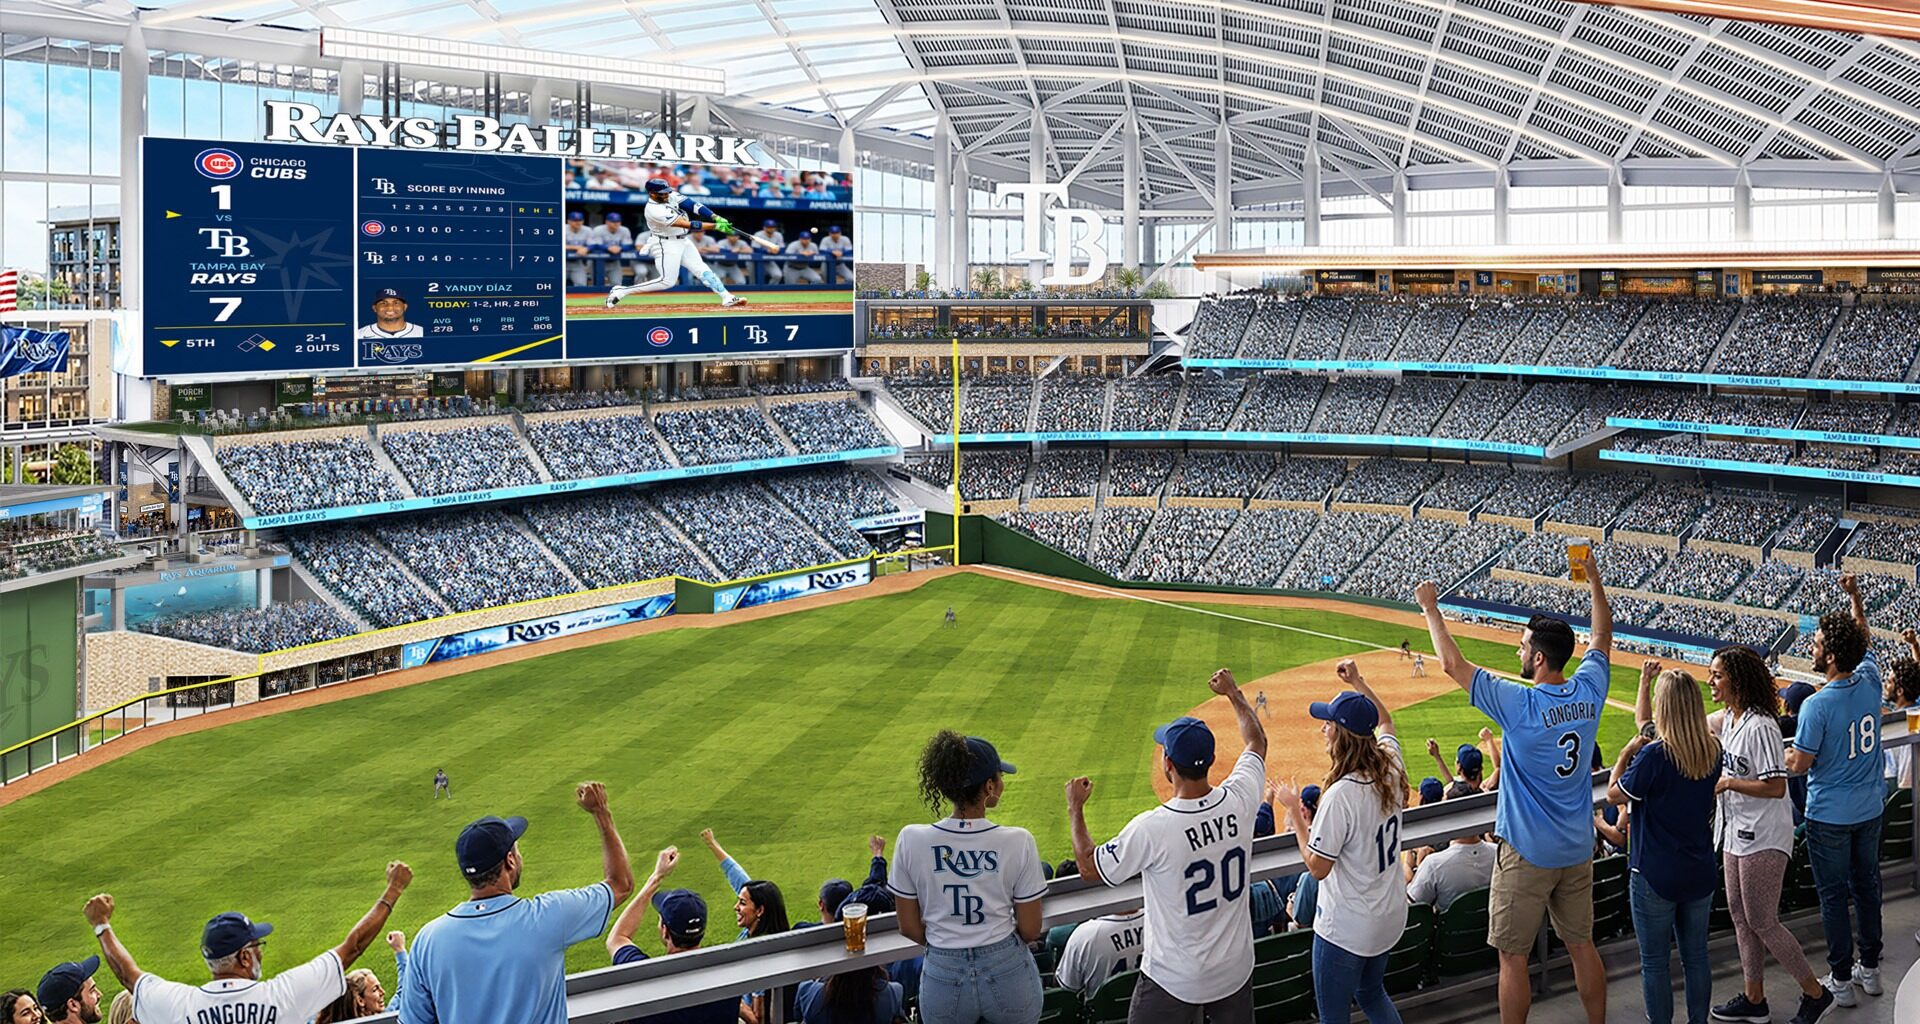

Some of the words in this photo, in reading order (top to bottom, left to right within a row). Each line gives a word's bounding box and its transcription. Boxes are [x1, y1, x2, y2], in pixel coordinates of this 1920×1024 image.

[264, 99, 437, 150] RAYS
[454, 113, 760, 166] BALLPARK
[250, 157, 306, 168] CHICAGO
[250, 167, 307, 180] CUBS
[371, 178, 397, 195] TB
[407, 184, 446, 193] SCORE
[449, 186, 464, 194] BY
[466, 187, 506, 196] INNING
[209, 184, 231, 210] 1
[215, 214, 233, 222] VS
[390, 225, 398, 233] 0
[431, 226, 439, 234] 0
[444, 226, 452, 234] 0
[533, 228, 540, 236] 3
[547, 228, 555, 236] 0
[995, 182, 1109, 286] TB
[444, 255, 452, 263] 0
[189, 262, 237, 271] TAMPA
[240, 262, 266, 271] BAY
[190, 273, 257, 285] RAYS
[428, 283, 440, 293] 2
[445, 284, 484, 293] YANDY
[536, 283, 552, 291] DH
[208, 297, 242, 323] 7
[428, 301, 471, 309] TODAY:
[473, 301, 493, 309] 1-2,
[494, 301, 512, 309] HR,
[522, 300, 540, 308] RBI
[500, 316, 515, 324] RBI
[533, 315, 551, 323] OPS
[430, 325, 454, 333] .278
[501, 324, 514, 332] 25
[530, 323, 553, 331] .806
[305, 334, 327, 342] 2-1
[688, 327, 698, 345] 1
[744, 325, 769, 345] TB
[784, 325, 799, 342] 7
[186, 339, 216, 348] 5TH
[295, 345, 304, 353] 2
[306, 343, 341, 353] OUTS
[1556, 368, 1577, 376] TAMPA
[1591, 370, 1608, 378] RAYS
[1658, 373, 1675, 381] RAYS
[1727, 376, 1750, 385] TAMPA
[1750, 378, 1763, 386] BAY
[1763, 378, 1781, 387] RAYS
[178, 387, 204, 397] PORCH
[1658, 420, 1681, 430] TAMPA
[1681, 423, 1696, 431] BAY
[1696, 424, 1710, 433] RAYS
[1744, 428, 1761, 436] RAYS
[1823, 433, 1847, 442] TAMPA
[1847, 435, 1862, 443] BAY
[1862, 436, 1881, 444] RAYS
[1465, 441, 1490, 450] TAMPA
[1491, 443, 1507, 452] BAY
[1507, 444, 1526, 453] RAYS
[1655, 456, 1678, 465] TAMPA
[1679, 457, 1691, 466] BAY
[1691, 458, 1707, 467] RAYS
[1827, 470, 1850, 479] TAMPA
[1851, 472, 1865, 481] BAY
[1865, 473, 1885, 483] RAYS
[551, 484, 567, 492] RAYS
[568, 482, 578, 490] UP
[432, 496, 457, 506] TAMPA
[458, 494, 472, 503] BAY
[473, 492, 492, 501] RAYS
[258, 516, 286, 527] TAMPA
[288, 514, 304, 524] BAY
[305, 510, 327, 521] RAYS
[807, 569, 857, 591] RAYS
[505, 619, 562, 645] RAYS
[1541, 702, 1597, 730] LONGORIA
[1847, 713, 1877, 761] 18
[1554, 731, 1582, 779] 3
[1184, 814, 1239, 852] RAYS
[1375, 814, 1399, 874] 12
[931, 844, 999, 879] RAYS
[1184, 846, 1246, 916] 20
[942, 884, 985, 926] TB
[1111, 926, 1144, 952] RAY
